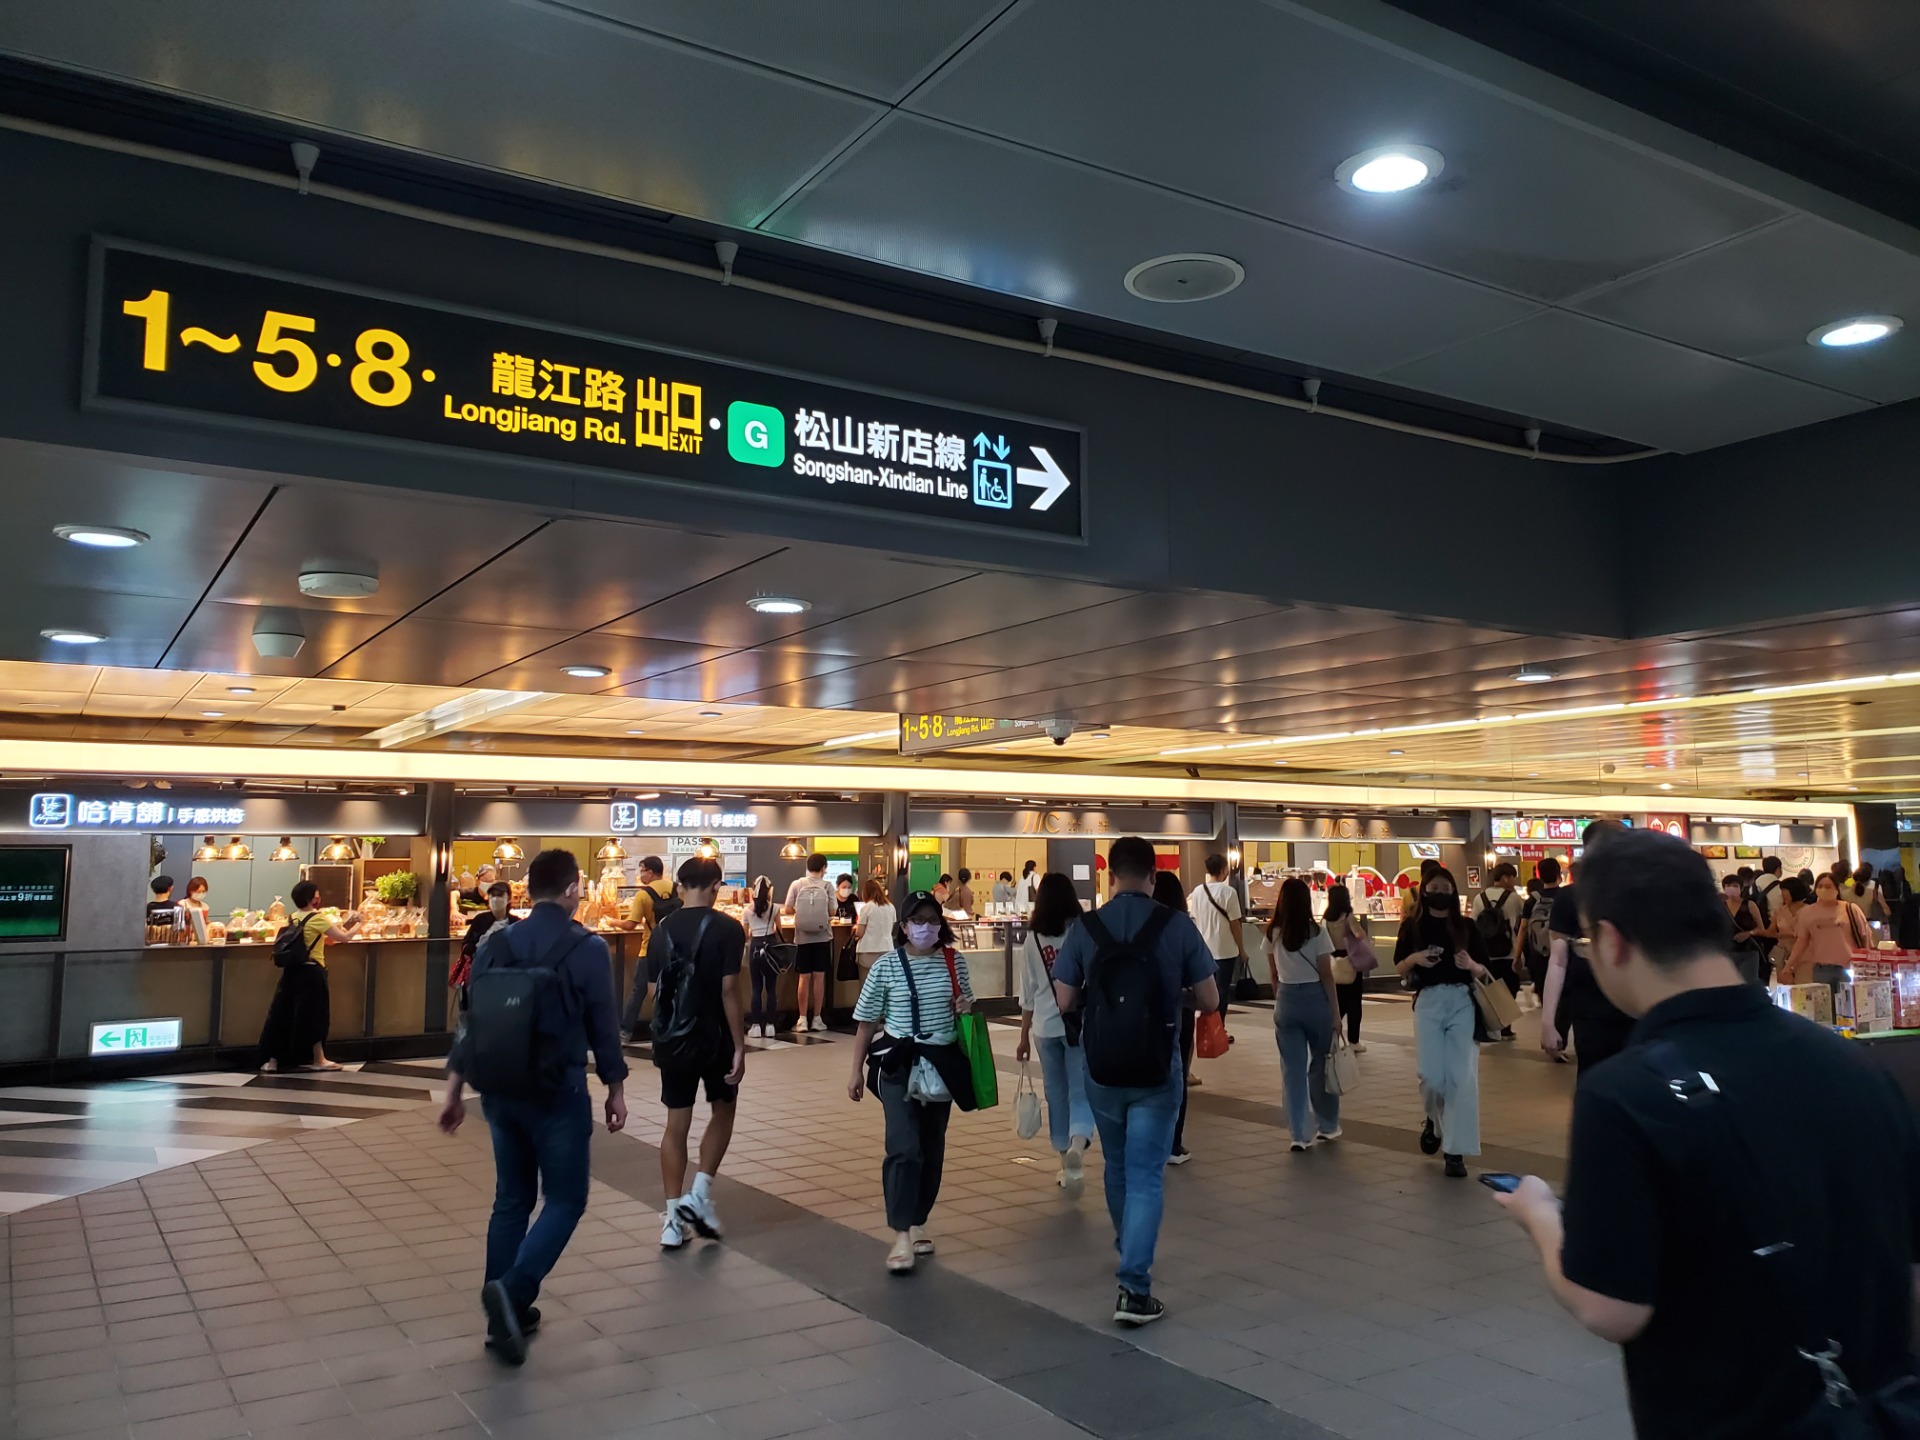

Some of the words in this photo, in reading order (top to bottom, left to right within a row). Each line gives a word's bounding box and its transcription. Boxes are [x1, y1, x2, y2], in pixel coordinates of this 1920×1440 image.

[444, 395, 577, 442] Longjiang
[584, 416, 627, 445] Rd.
[492, 351, 625, 414] 龍江路
[634, 376, 702, 452] 出口
[669, 430, 703, 455] EXIT
[744, 420, 768, 449] G
[793, 407, 967, 472] 松山新店線
[793, 453, 934, 495] Songshan-Xindian
[938, 475, 969, 501] Line
[946, 726, 971, 738] Longjiang
[177, 807, 246, 825] 手感烘焙
